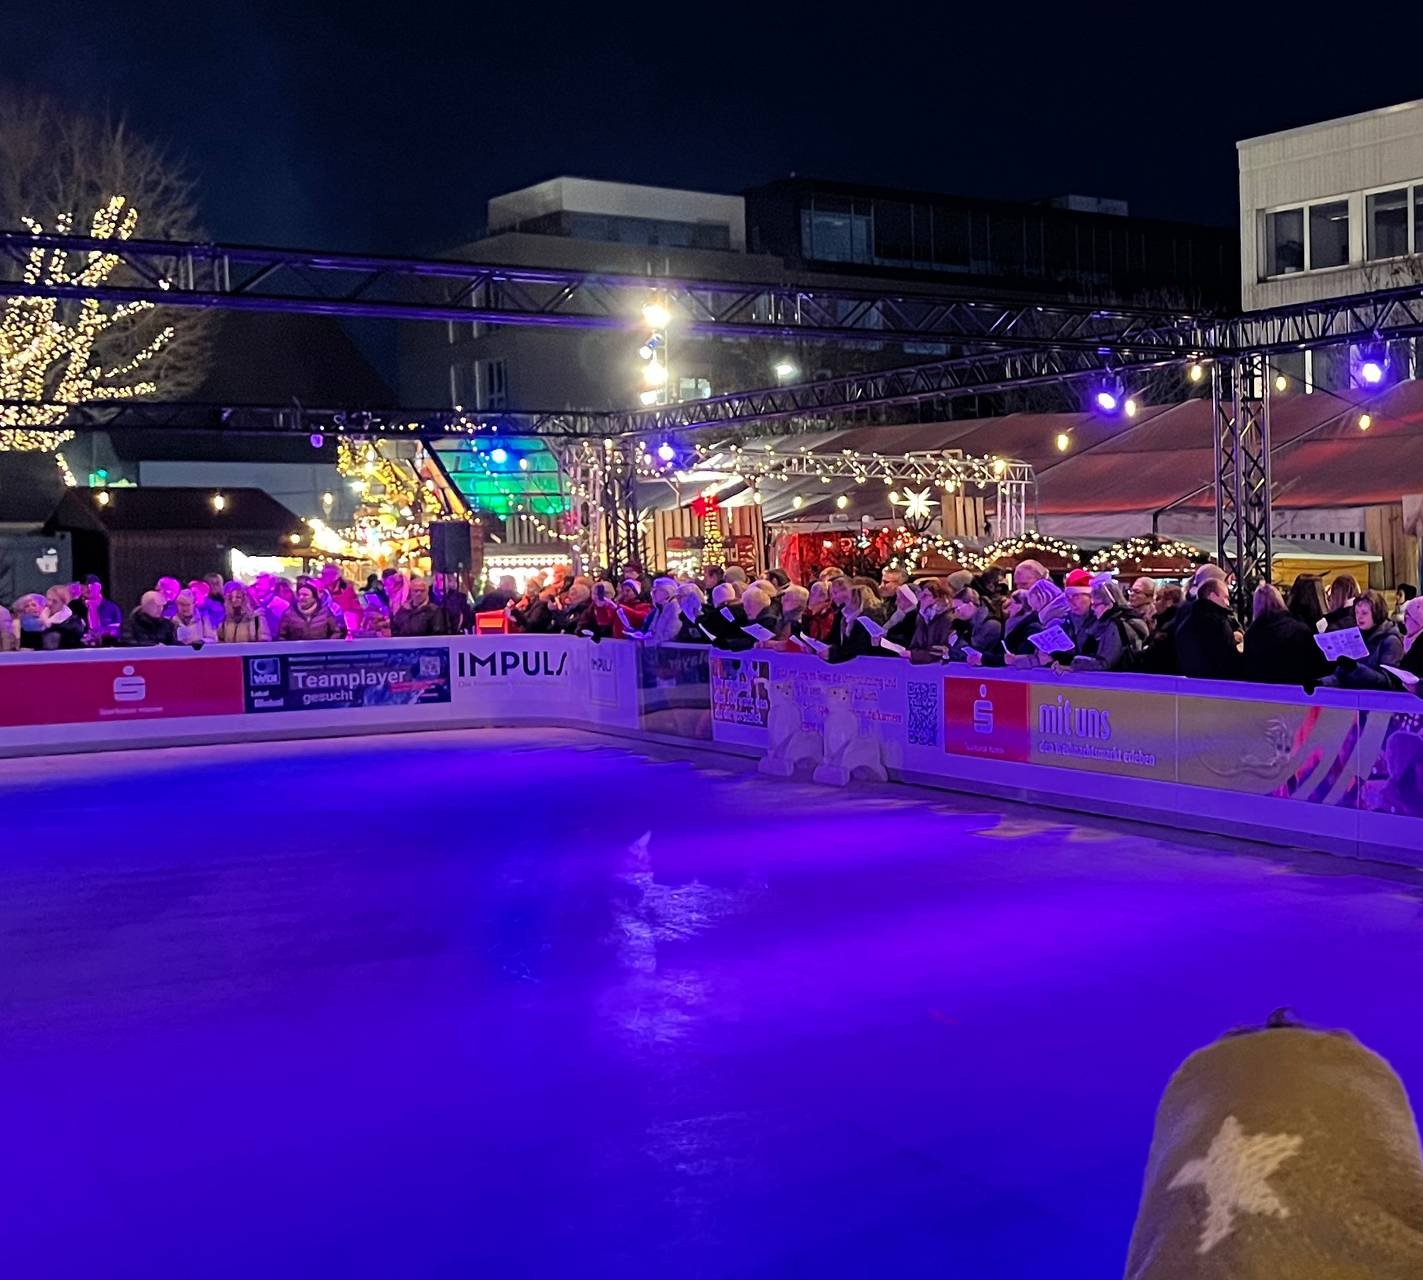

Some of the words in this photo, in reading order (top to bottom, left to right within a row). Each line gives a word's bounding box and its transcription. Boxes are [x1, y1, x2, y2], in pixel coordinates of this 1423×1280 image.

[293, 669, 406, 689] Teamplayer
[302, 690, 353, 705] gesucht
[1039, 694, 1072, 736] mit
[1075, 707, 1111, 740] uns
[1123, 749, 1156, 766] erleben
